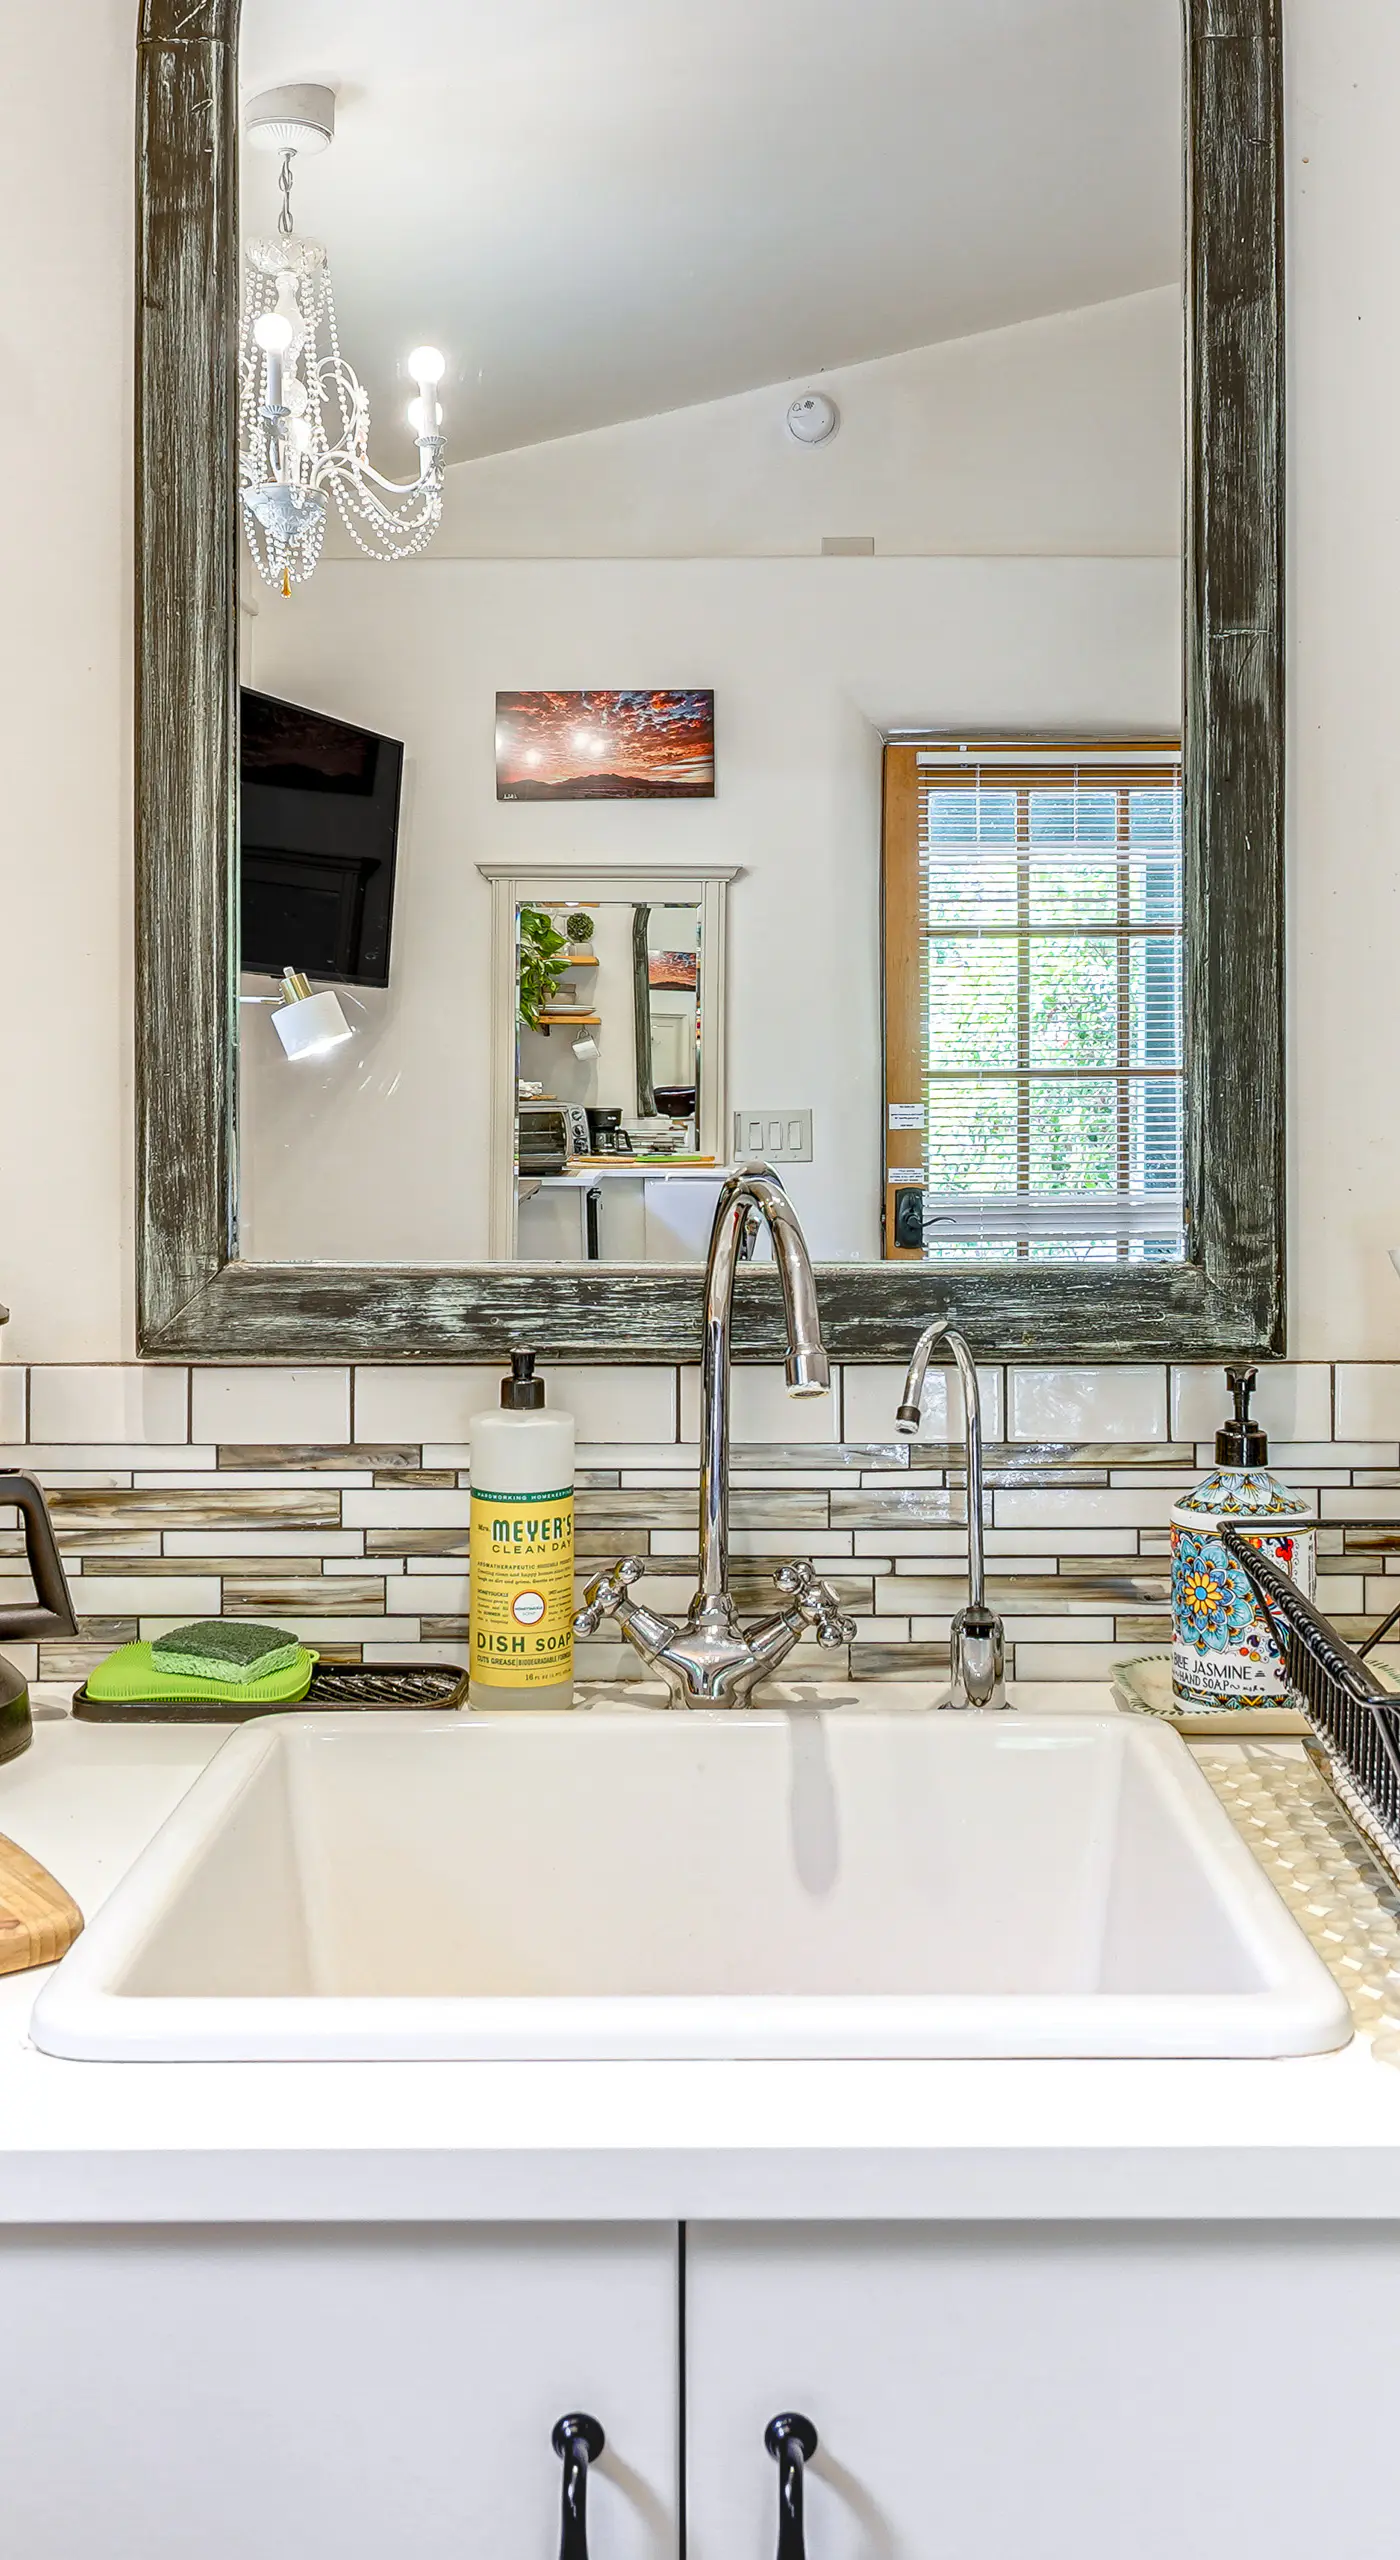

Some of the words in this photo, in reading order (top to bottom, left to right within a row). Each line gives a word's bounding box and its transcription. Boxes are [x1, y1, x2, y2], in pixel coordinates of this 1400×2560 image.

[492, 1514, 572, 1542] MEYER'S
[492, 1544, 546, 1554] CLEAN
[551, 1540, 571, 1552] DAY
[477, 1631, 525, 1653] DISH
[535, 1631, 572, 1652] SOAP
[477, 1654, 490, 1664] CUTS
[490, 1657, 516, 1666] GREASE
[1192, 1660, 1252, 1680] JASMINE
[525, 1673, 534, 1681] 16
[1179, 1670, 1201, 1687] HAND
[1202, 1677, 1230, 1691] SOAP
